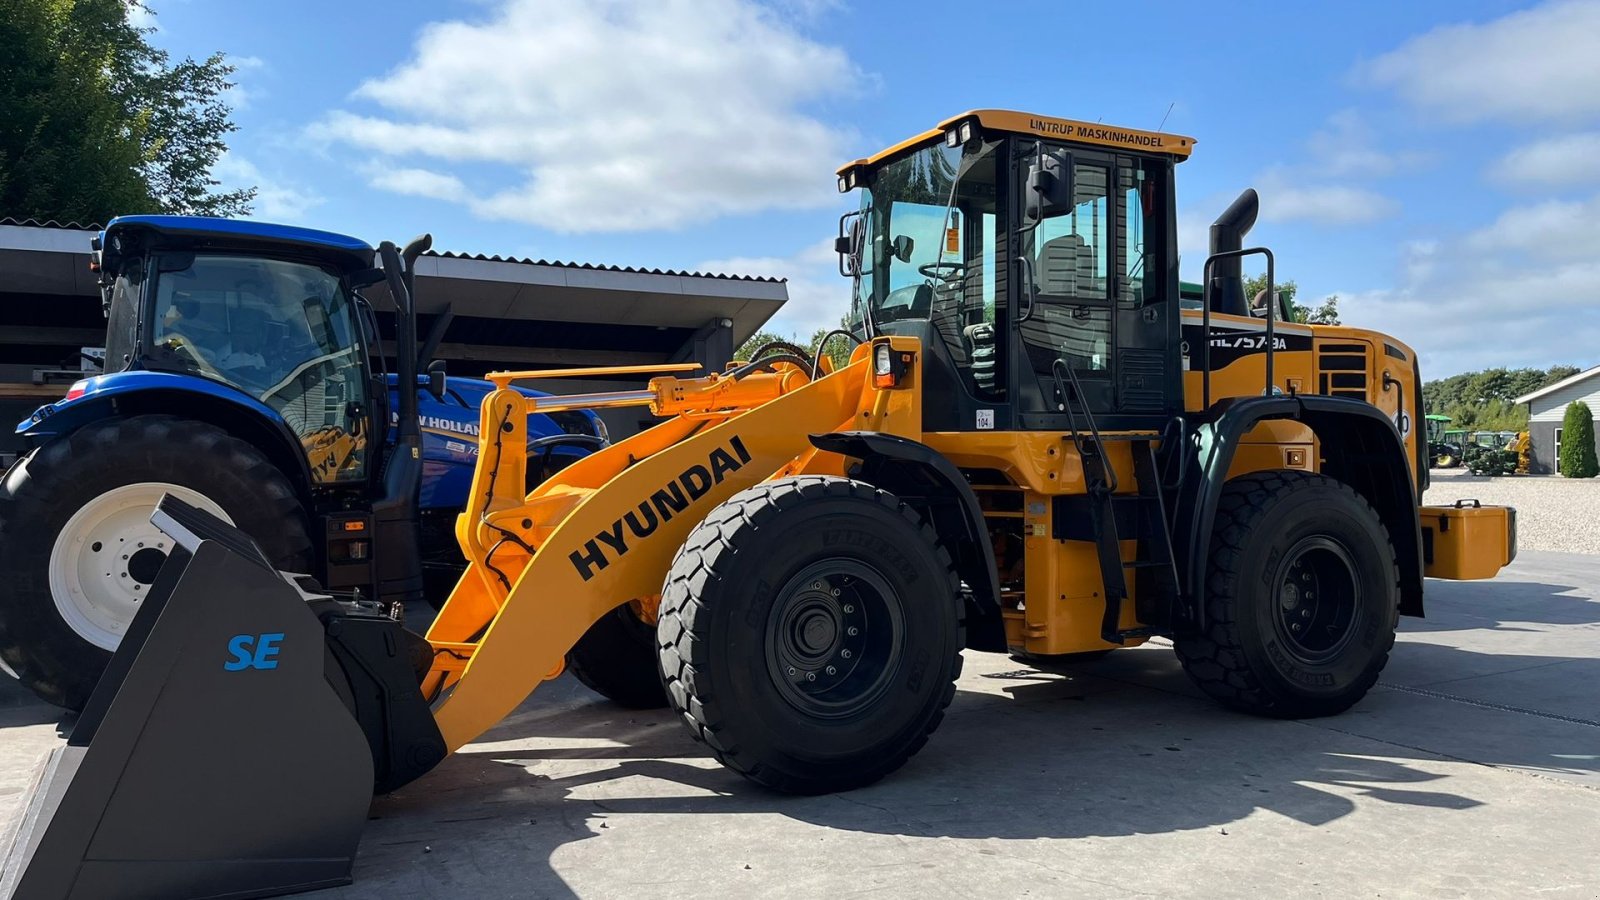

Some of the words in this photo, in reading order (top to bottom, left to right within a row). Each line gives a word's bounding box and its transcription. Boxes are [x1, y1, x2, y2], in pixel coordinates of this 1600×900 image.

[1030, 119, 1074, 135] LINTRUP
[1077, 126, 1163, 147] MASKINHANDEL
[428, 417, 480, 436] HOLLAN
[978, 418, 988, 428] 104
[568, 435, 752, 582] HYUNDAI
[224, 632, 285, 671] SE
